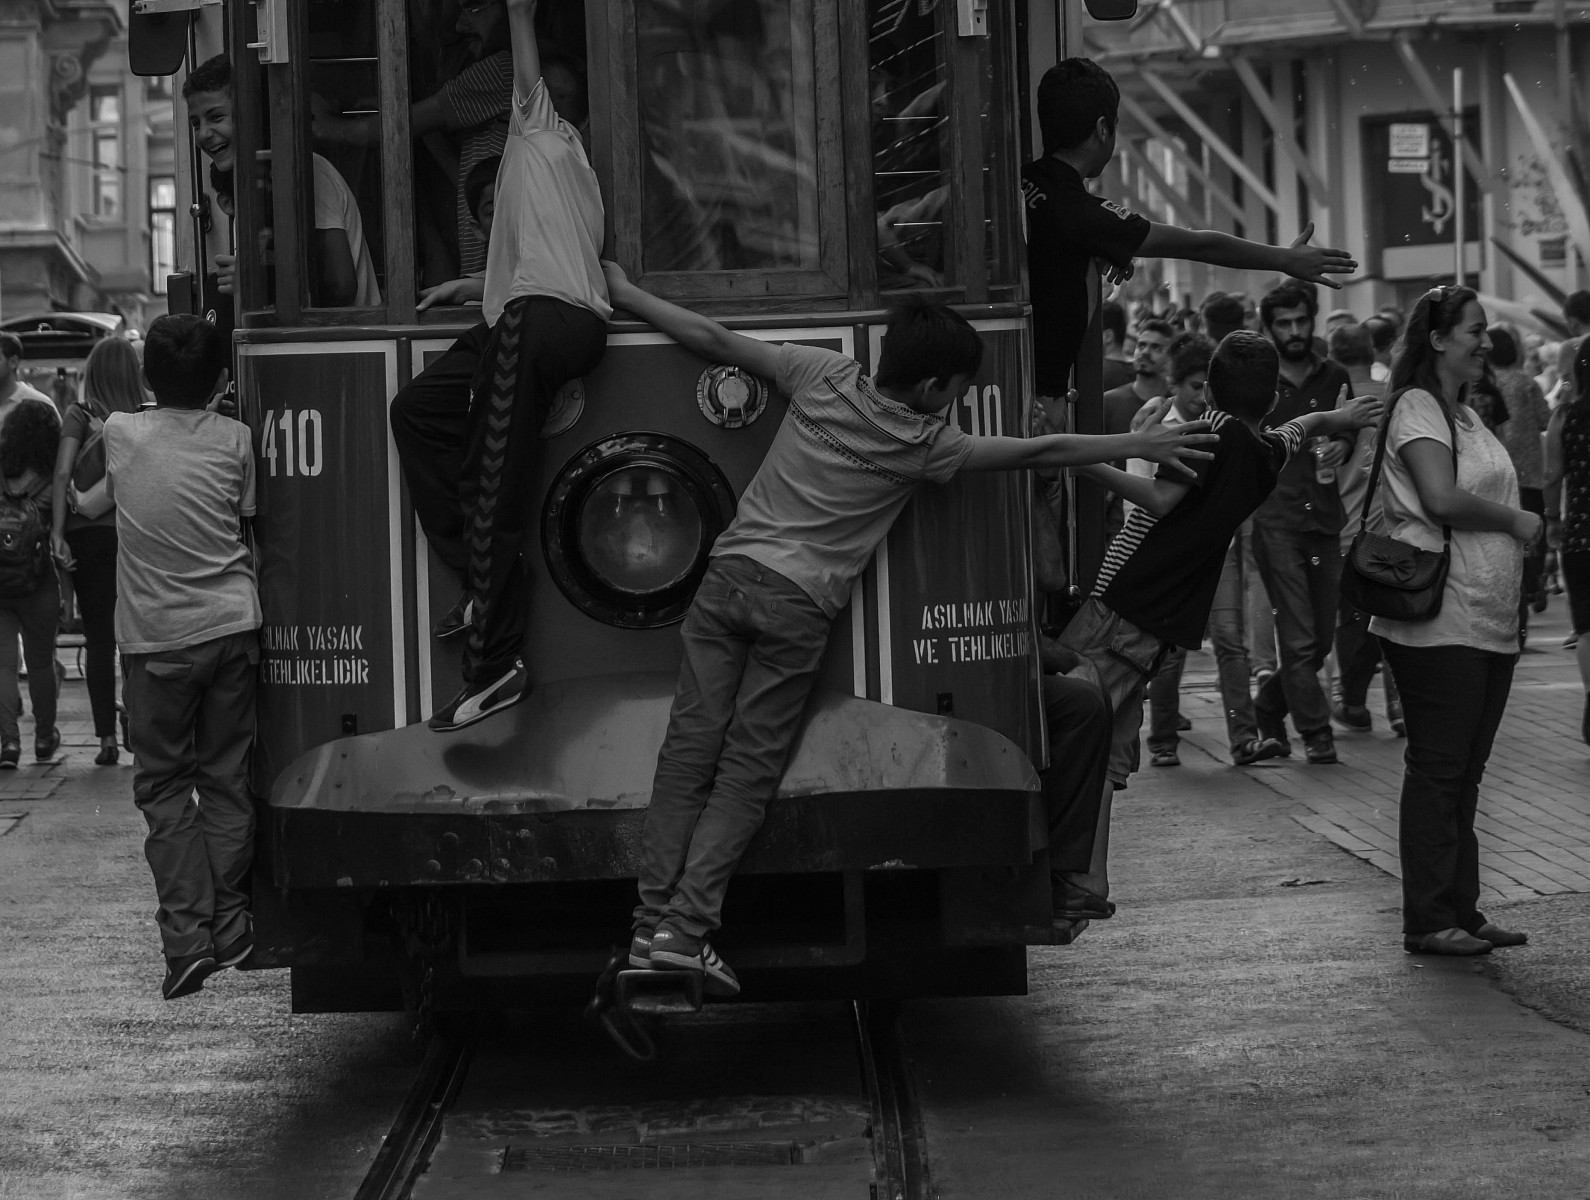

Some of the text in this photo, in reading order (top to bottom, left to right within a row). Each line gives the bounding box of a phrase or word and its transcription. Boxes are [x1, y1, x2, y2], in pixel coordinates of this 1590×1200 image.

[261, 409, 323, 477] 410
[921, 600, 994, 630] ASILMAK
[306, 624, 363, 650] YASAK
[913, 638, 939, 664] VE
[268, 655, 369, 685] TEHLİKELİDİR
